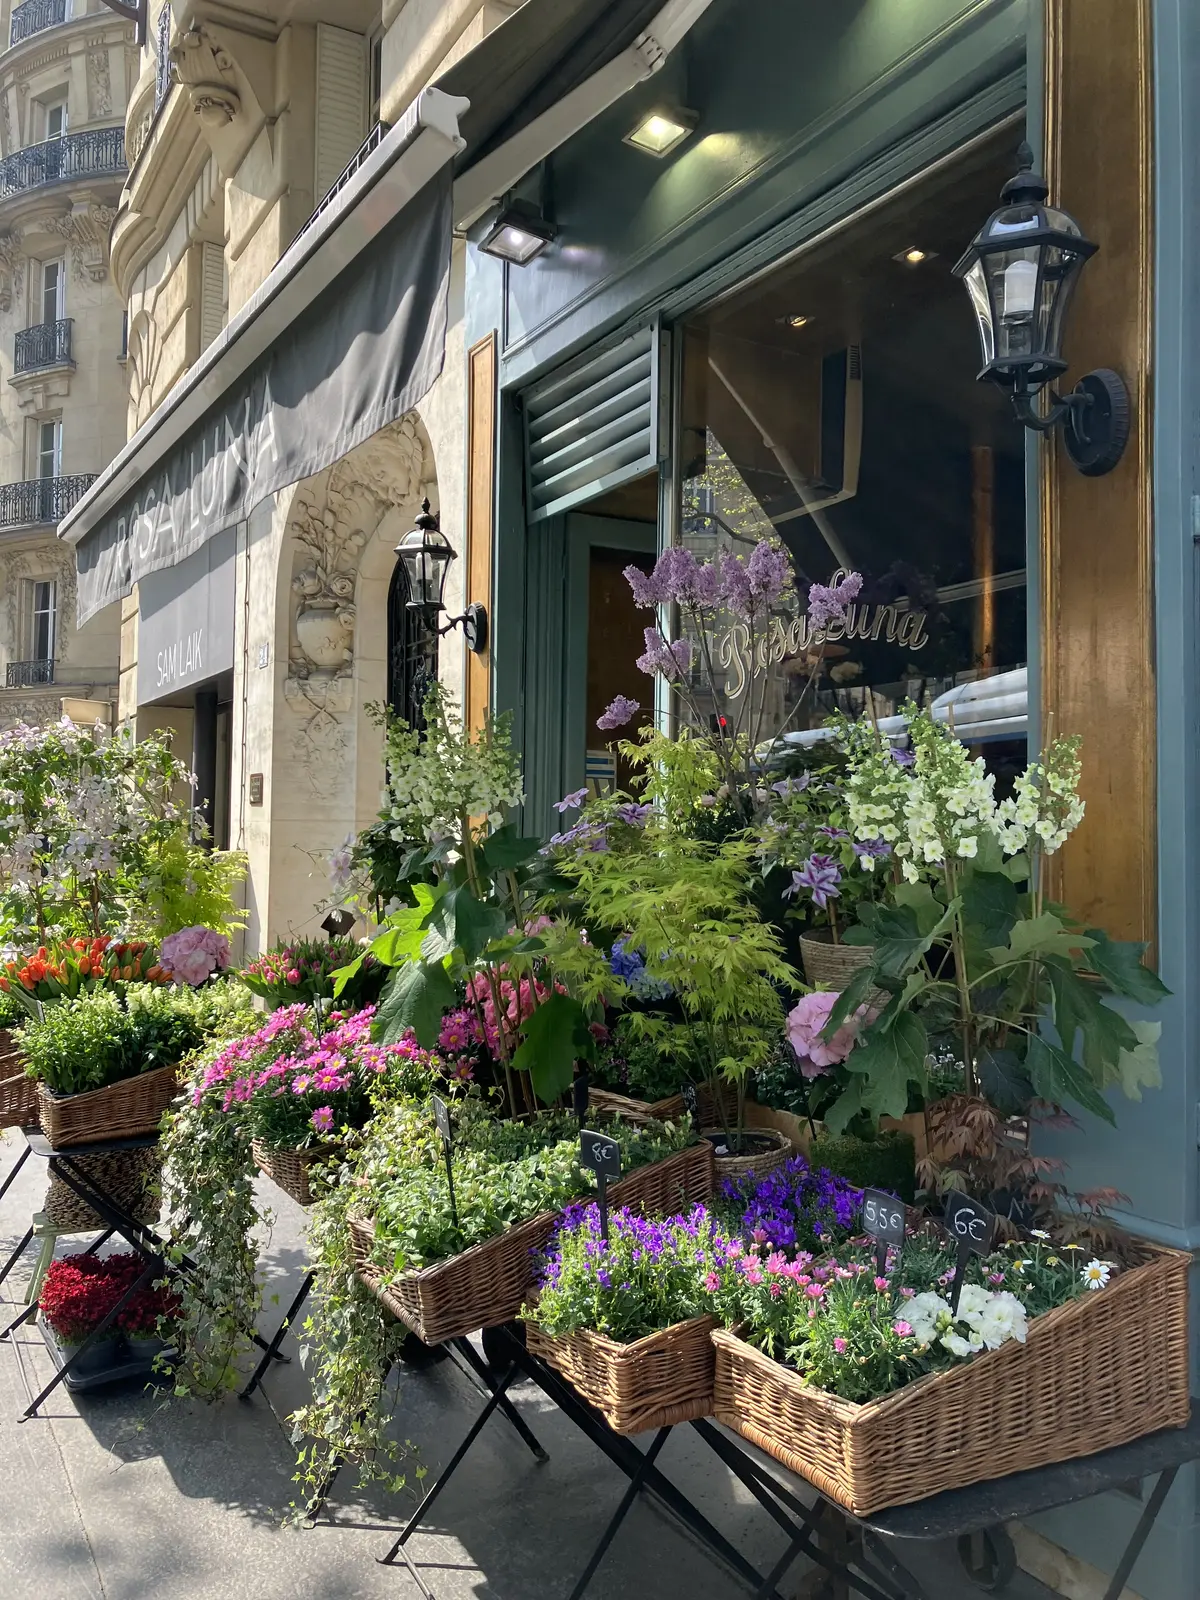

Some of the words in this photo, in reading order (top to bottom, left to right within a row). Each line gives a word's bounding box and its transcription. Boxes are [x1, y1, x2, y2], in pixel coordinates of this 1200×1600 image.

[114, 473, 177, 578] ROSA
[190, 373, 279, 531] LUNA
[156, 643, 177, 687] SAM
[179, 628, 203, 677] LAIK
[592, 1142, 613, 1162] 8€
[954, 1207, 987, 1241] 6€
